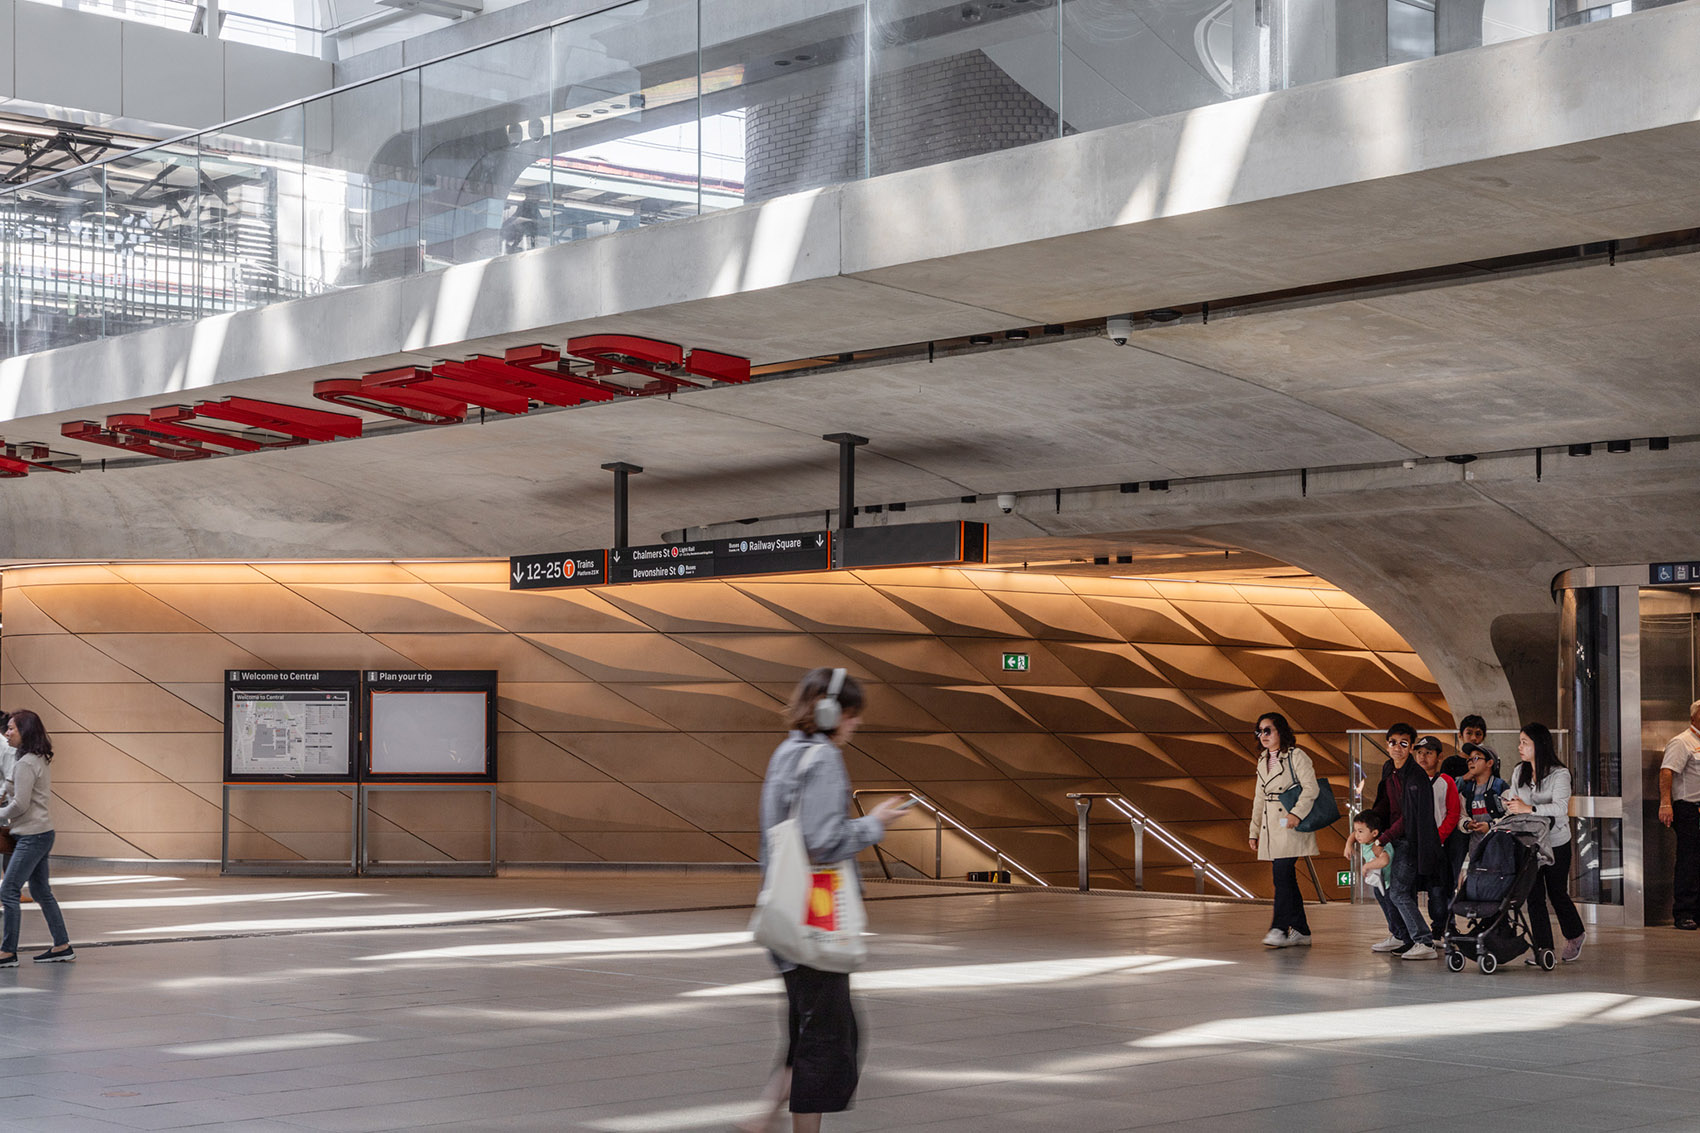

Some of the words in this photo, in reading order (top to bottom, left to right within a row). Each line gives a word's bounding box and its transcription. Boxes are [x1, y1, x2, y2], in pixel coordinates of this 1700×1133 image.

[749, 540, 776, 551] Railway
[776, 539, 802, 551] Square
[633, 550, 662, 560] Chalmers
[663, 548, 670, 558] St
[577, 560, 595, 569] Trains
[526, 562, 561, 580] 12-25
[633, 567, 669, 578] Devonshire
[669, 566, 676, 575] St
[1692, 566, 1700, 578] L
[241, 672, 279, 680] Welcome
[280, 672, 288, 680] to
[290, 672, 320, 680] Central
[380, 672, 397, 680] Plan
[398, 673, 416, 682] your
[418, 672, 432, 682] trip
